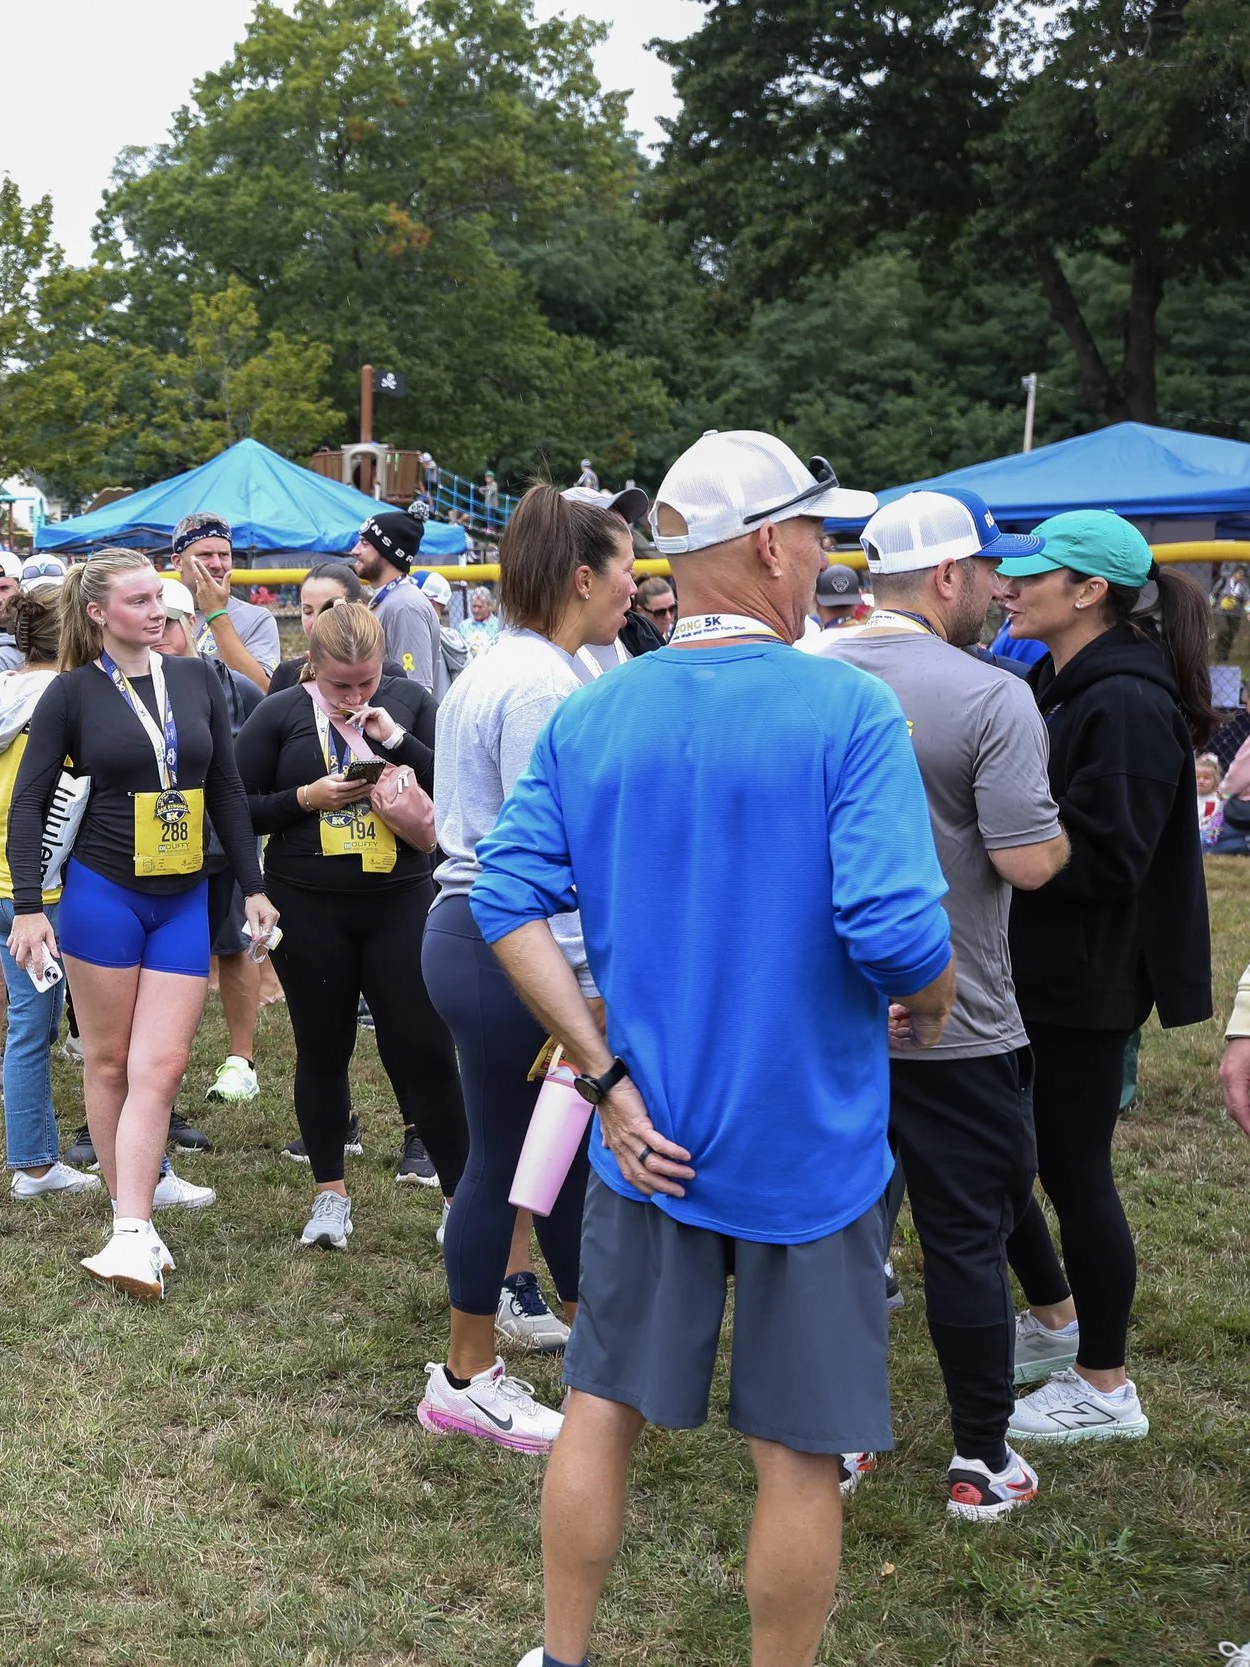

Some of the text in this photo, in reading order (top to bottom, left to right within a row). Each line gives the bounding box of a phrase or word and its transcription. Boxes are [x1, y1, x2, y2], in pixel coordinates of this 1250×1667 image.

[704, 616, 722, 627] 5K
[162, 822, 188, 842] 288
[350, 821, 376, 840] 194
